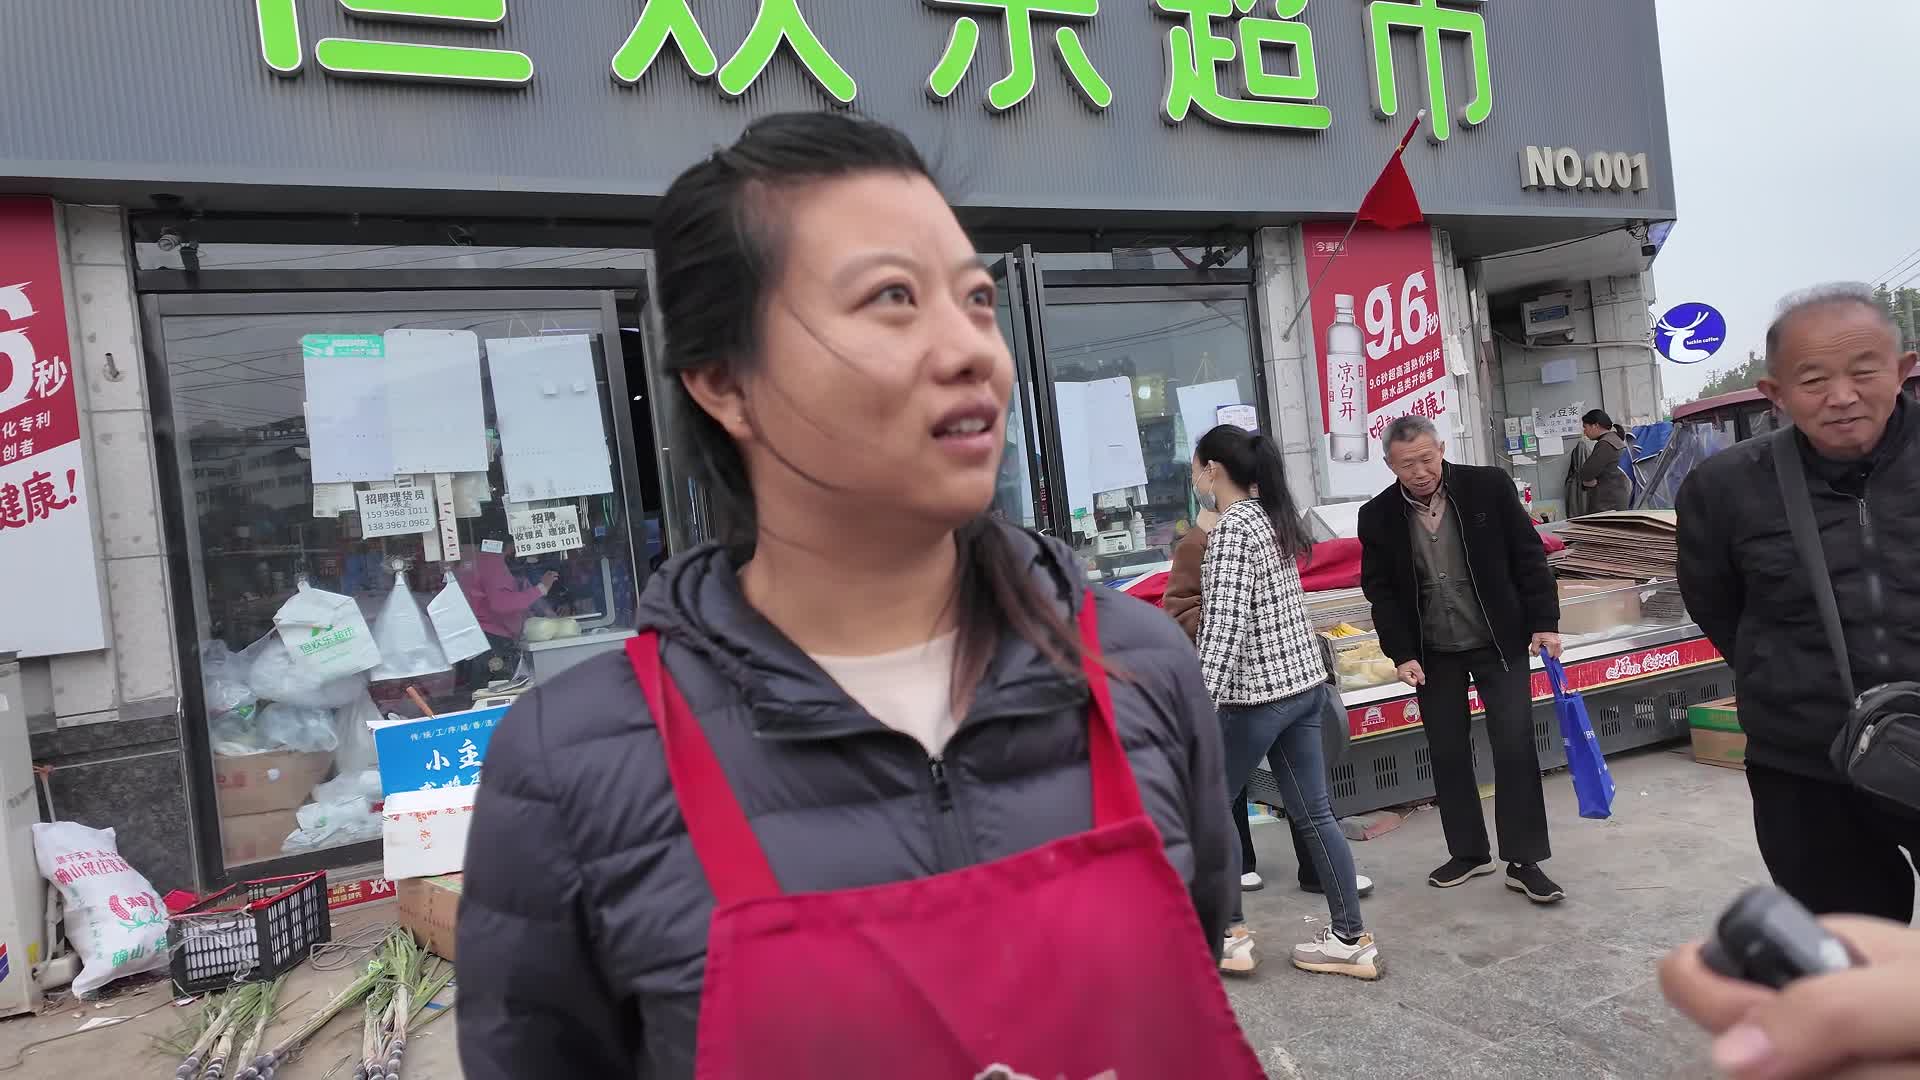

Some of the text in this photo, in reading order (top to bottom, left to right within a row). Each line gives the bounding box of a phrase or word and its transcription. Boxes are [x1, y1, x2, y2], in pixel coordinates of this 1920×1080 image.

[1521, 145, 1649, 189] NO.001
[1365, 270, 1439, 360] 9.6秒
[1, 410, 51, 439] 化专利
[1369, 390, 1446, 440] 喝健康!
[2, 438, 34, 461] 创者
[365, 489, 425, 505] 招聘理货员
[366, 506, 428, 519] 159 3968 1011
[531, 511, 556, 524] 招聘
[367, 518, 430, 532] 138 3962 0962
[516, 536, 581, 553] 159 3968 1011
[425, 738, 484, 771] 小主
